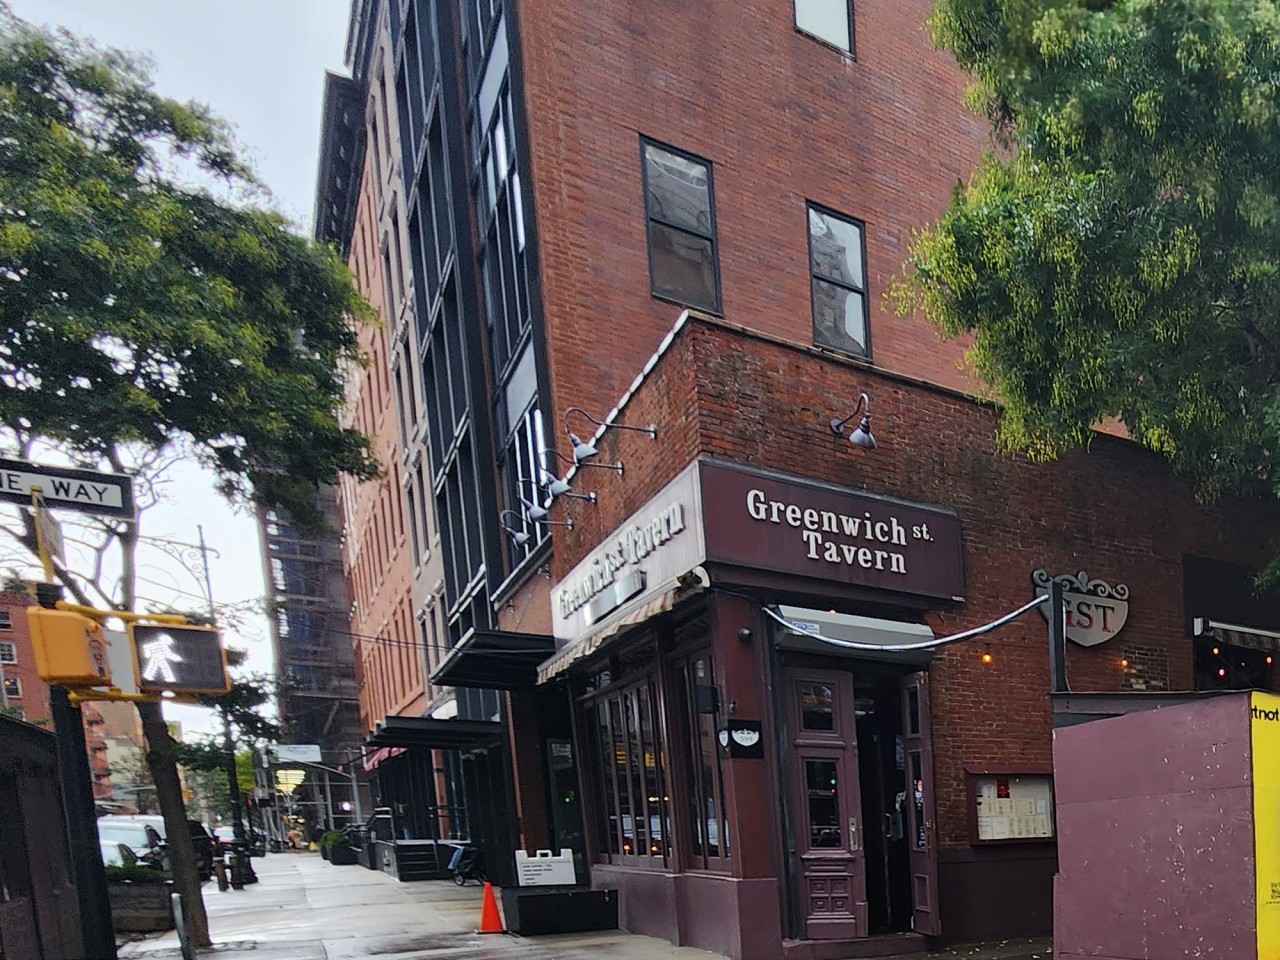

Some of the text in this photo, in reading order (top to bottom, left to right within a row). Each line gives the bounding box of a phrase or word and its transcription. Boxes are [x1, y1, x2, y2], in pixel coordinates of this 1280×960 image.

[51, 479, 108, 502] WAY
[627, 501, 686, 565] Tavern
[746, 489, 934, 546] Greenwich st.
[802, 530, 907, 574] Tavern
